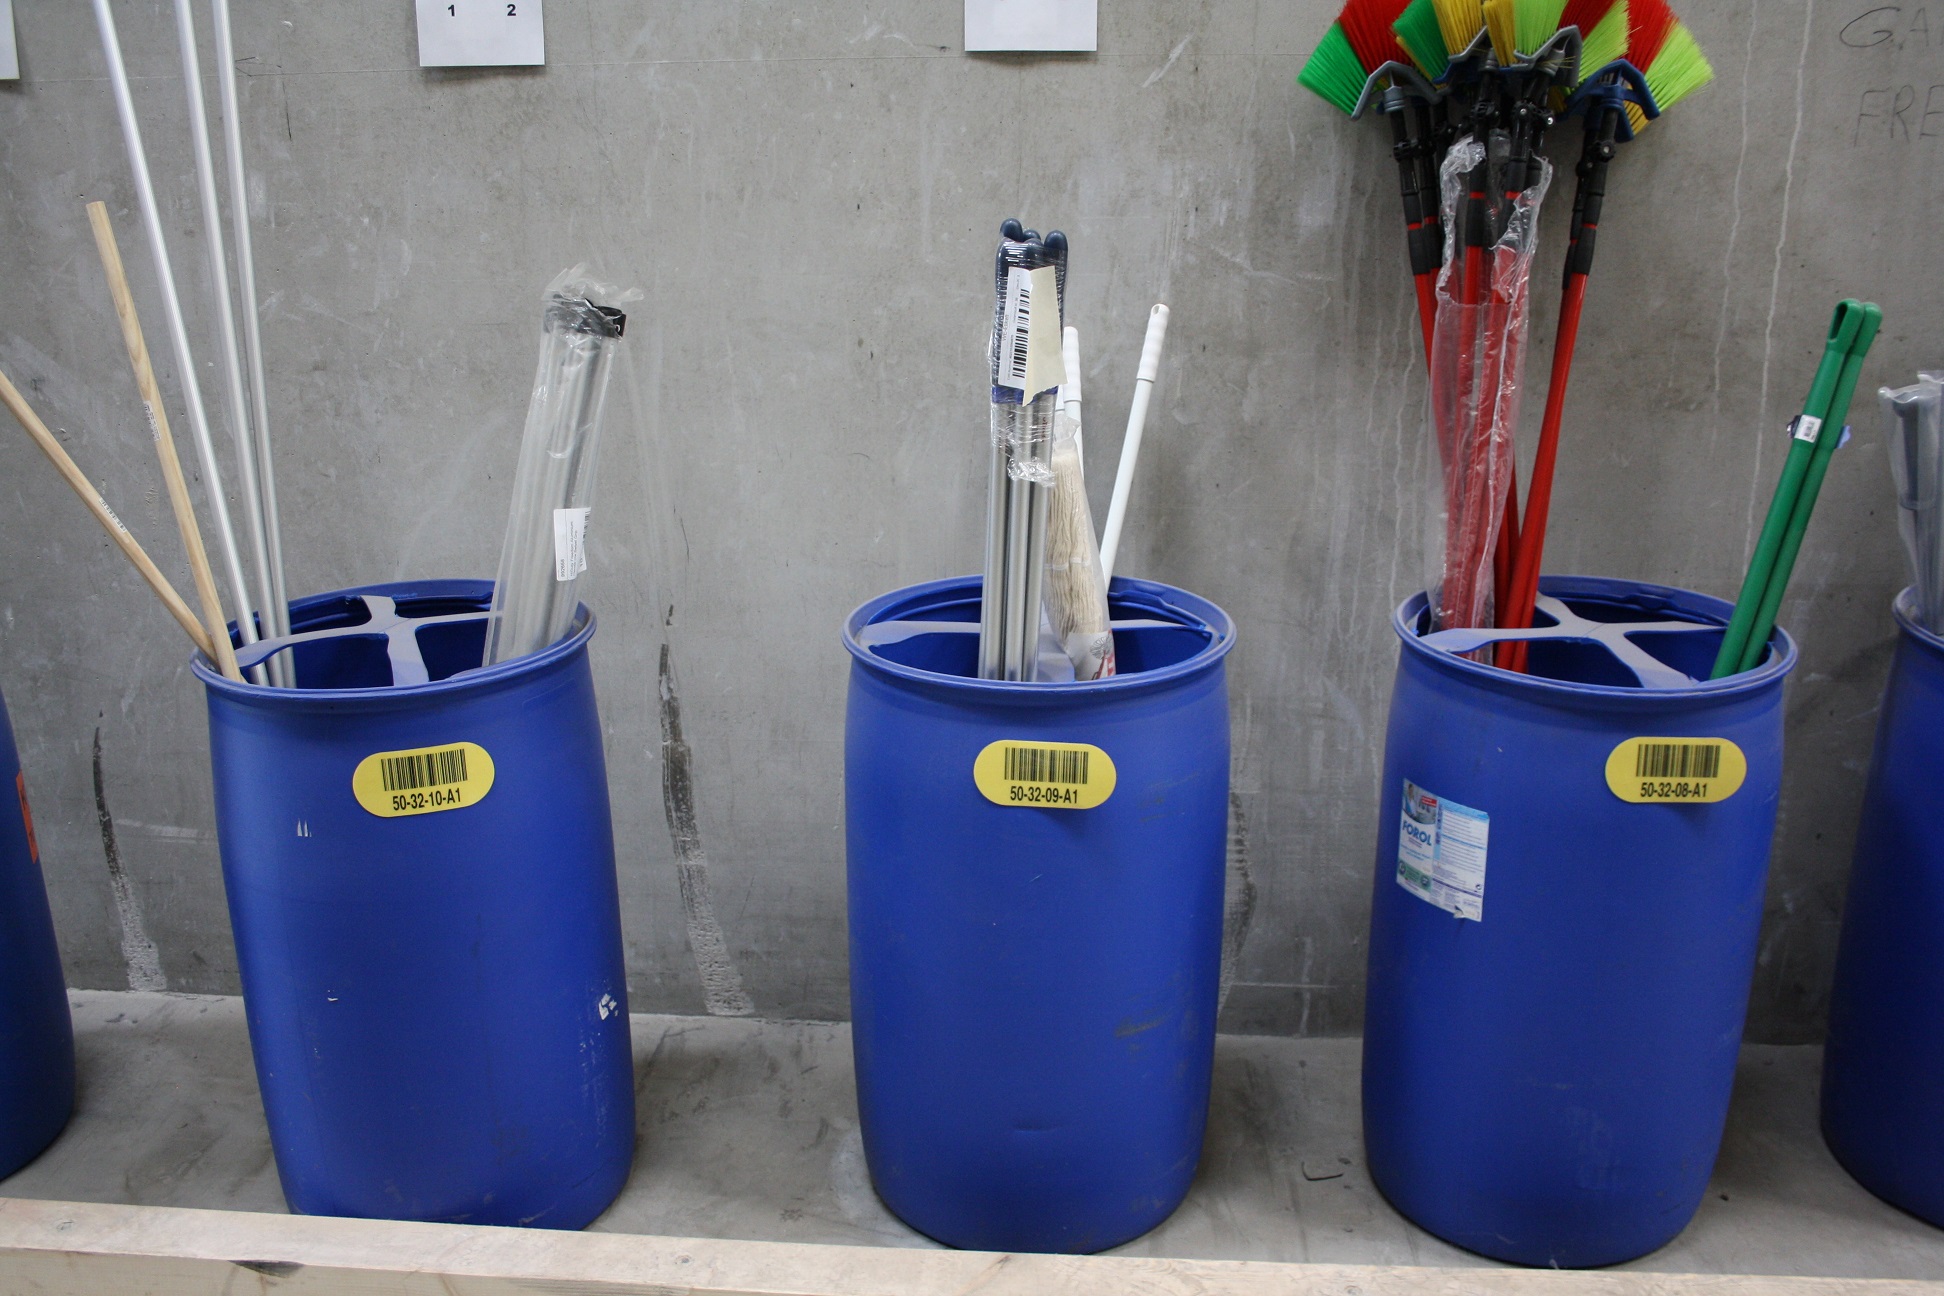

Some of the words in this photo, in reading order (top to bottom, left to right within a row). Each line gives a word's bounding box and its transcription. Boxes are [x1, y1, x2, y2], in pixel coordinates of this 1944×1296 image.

[447, 4, 456, 17] 1
[506, 4, 517, 17] 2
[392, 787, 462, 811] 50-32-10-A1
[1010, 785, 1078, 804] 50-32-09-A1
[1640, 782, 1708, 798] 50-32-08-A1
[1402, 820, 1432, 847] FOROL
